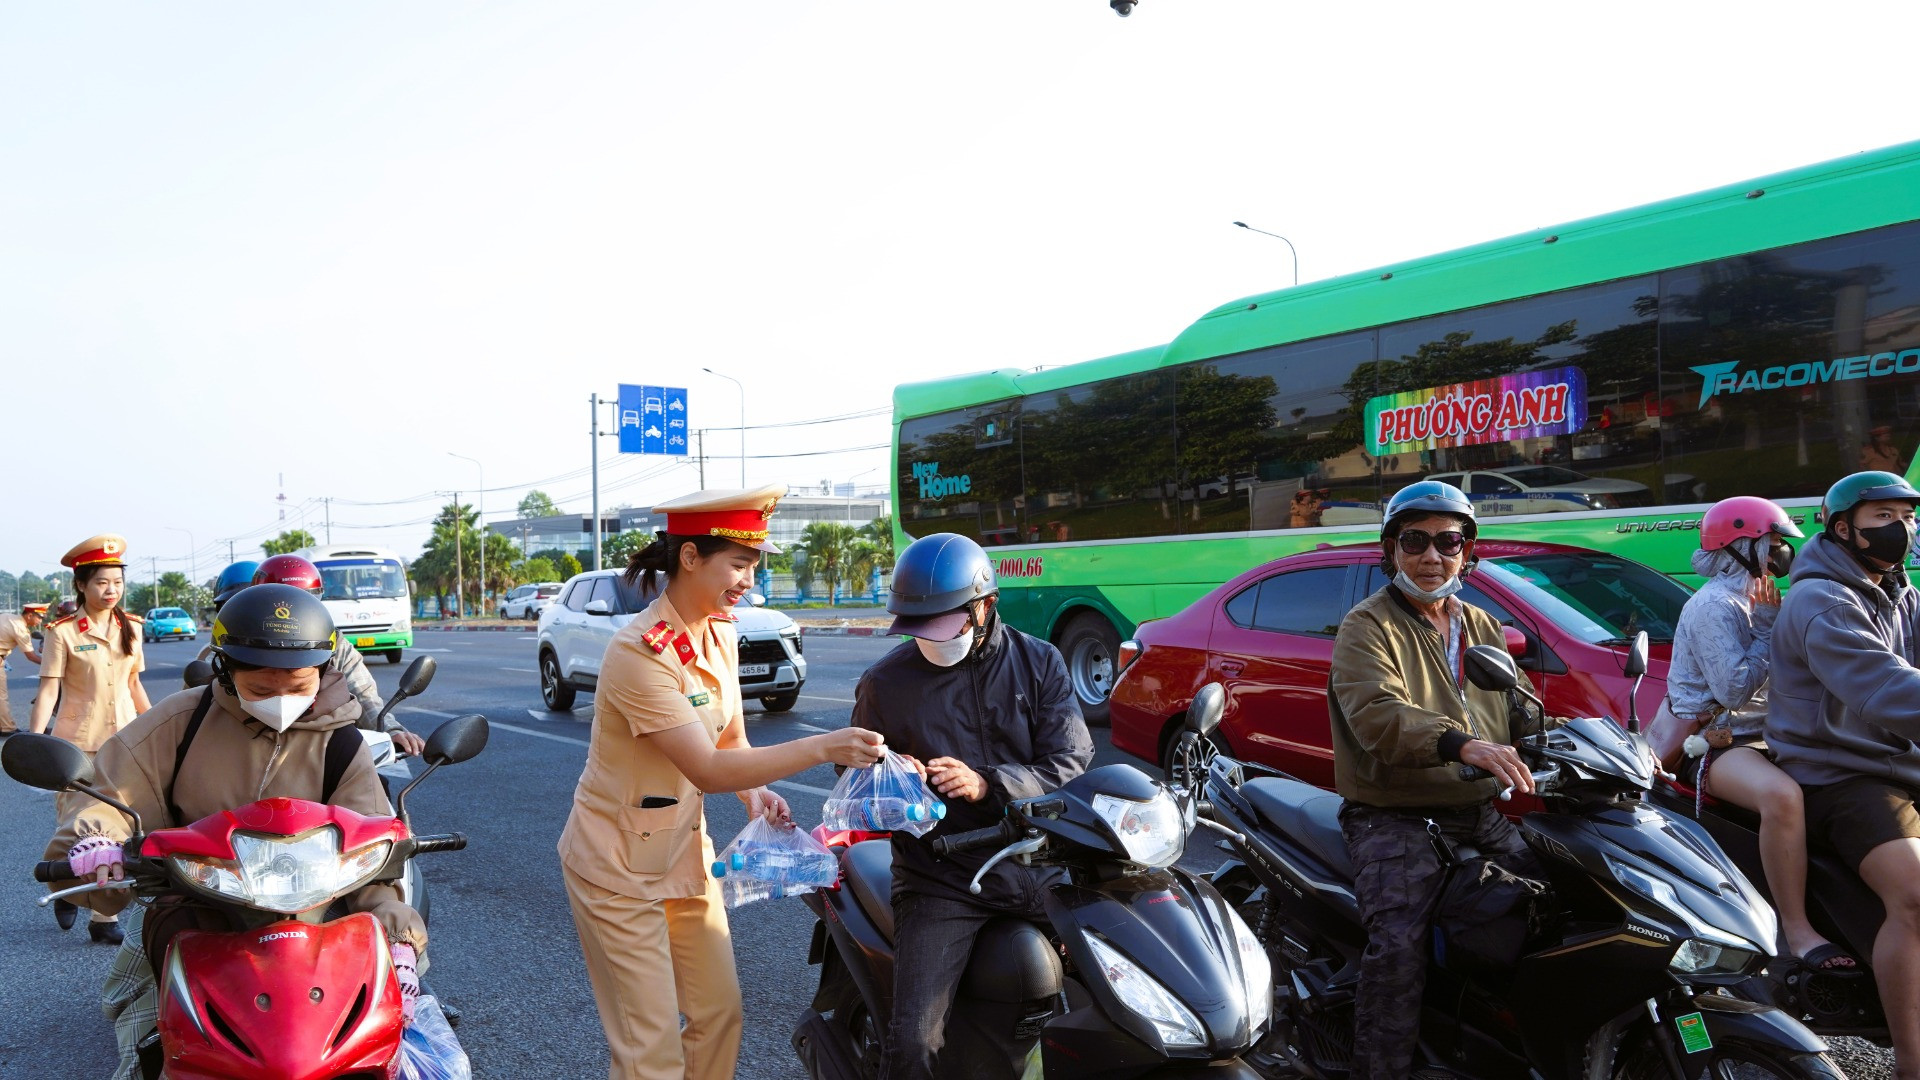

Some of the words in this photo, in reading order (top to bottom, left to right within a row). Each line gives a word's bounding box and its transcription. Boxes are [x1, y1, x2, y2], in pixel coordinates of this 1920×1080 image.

[1687, 347, 1920, 410] TRACOMECO
[1378, 393, 1492, 445] PHƯƠNG
[1495, 383, 1568, 430] ANH
[912, 461, 939, 478] New
[919, 474, 971, 499] Home
[1148, 895, 1181, 904] HONDA
[258, 931, 309, 944] HONDA
[1627, 923, 1671, 942] HONDA
